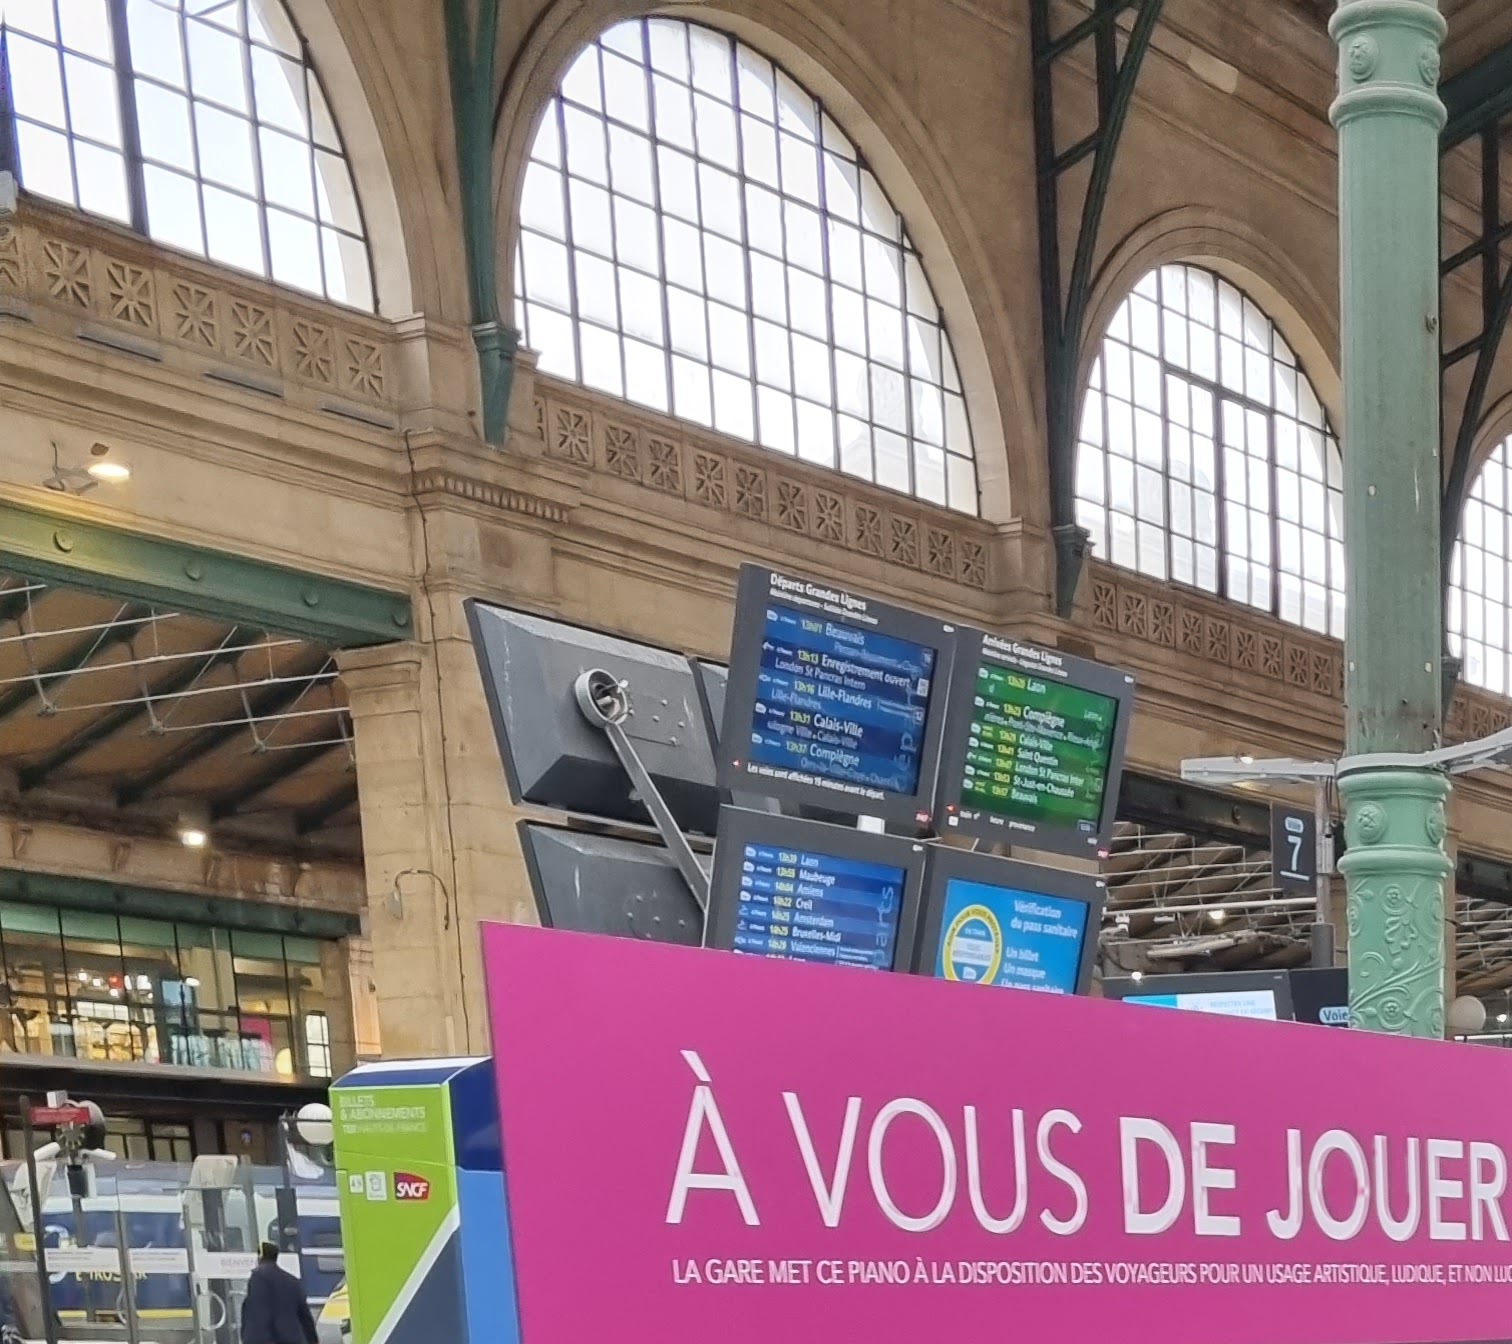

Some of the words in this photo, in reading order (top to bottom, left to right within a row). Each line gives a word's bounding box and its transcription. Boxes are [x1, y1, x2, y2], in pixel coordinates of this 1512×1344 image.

[806, 584, 839, 603] Grandes
[840, 590, 867, 611] Lignes
[1013, 643, 1040, 659] Grandes
[1041, 650, 1062, 666] Lignes
[775, 658, 803, 675] London
[805, 665, 813, 676] St
[815, 668, 842, 684] Pancras
[822, 655, 883, 681] Enregistrement
[884, 671, 910, 687] ouvert
[817, 684, 872, 709] Lille-Flandres
[814, 714, 863, 738] Calais-Ville
[810, 744, 860, 767] Compiègne
[1287, 835, 1302, 871] 7
[800, 869, 835, 887] Maubeuge
[796, 898, 812, 910] Creil
[1014, 899, 1061, 919] Vérification
[1011, 917, 1022, 929] du
[1023, 921, 1042, 933] pass
[1043, 923, 1078, 938] sanitaire
[1006, 947, 1017, 958] Un
[1019, 949, 1039, 962] billet
[1004, 963, 1015, 974] Un
[1016, 967, 1046, 979] masque
[1323, 1010, 1349, 1022] Voie
[666, 1050, 760, 1226] À
[783, 1091, 1088, 1236] VOUS
[1119, 1116, 1241, 1236] DE
[1266, 1128, 1510, 1242] JOUER
[396, 1182, 428, 1197] SNCF
[672, 1259, 702, 1284] LA
[705, 1258, 765, 1284] GARE
[768, 1260, 813, 1284] MET
[816, 1260, 845, 1284] CE
[847, 1260, 911, 1284] PIANO
[913, 1255, 930, 1284] À
[931, 1261, 956, 1284] LA
[958, 1261, 1068, 1284] DISPOSITION
[1071, 1262, 1103, 1284] DES
[1105, 1262, 1197, 1284] VOYAGEURS
[1199, 1263, 1240, 1284] POUR
[1242, 1263, 1264, 1284] UN
[1266, 1263, 1312, 1284] USAGE
[1314, 1263, 1390, 1286] ARTISTIQUE,
[1391, 1264, 1447, 1286] LUDIQUE,
[1448, 1264, 1464, 1283] ET
[1465, 1264, 1493, 1283] NON
